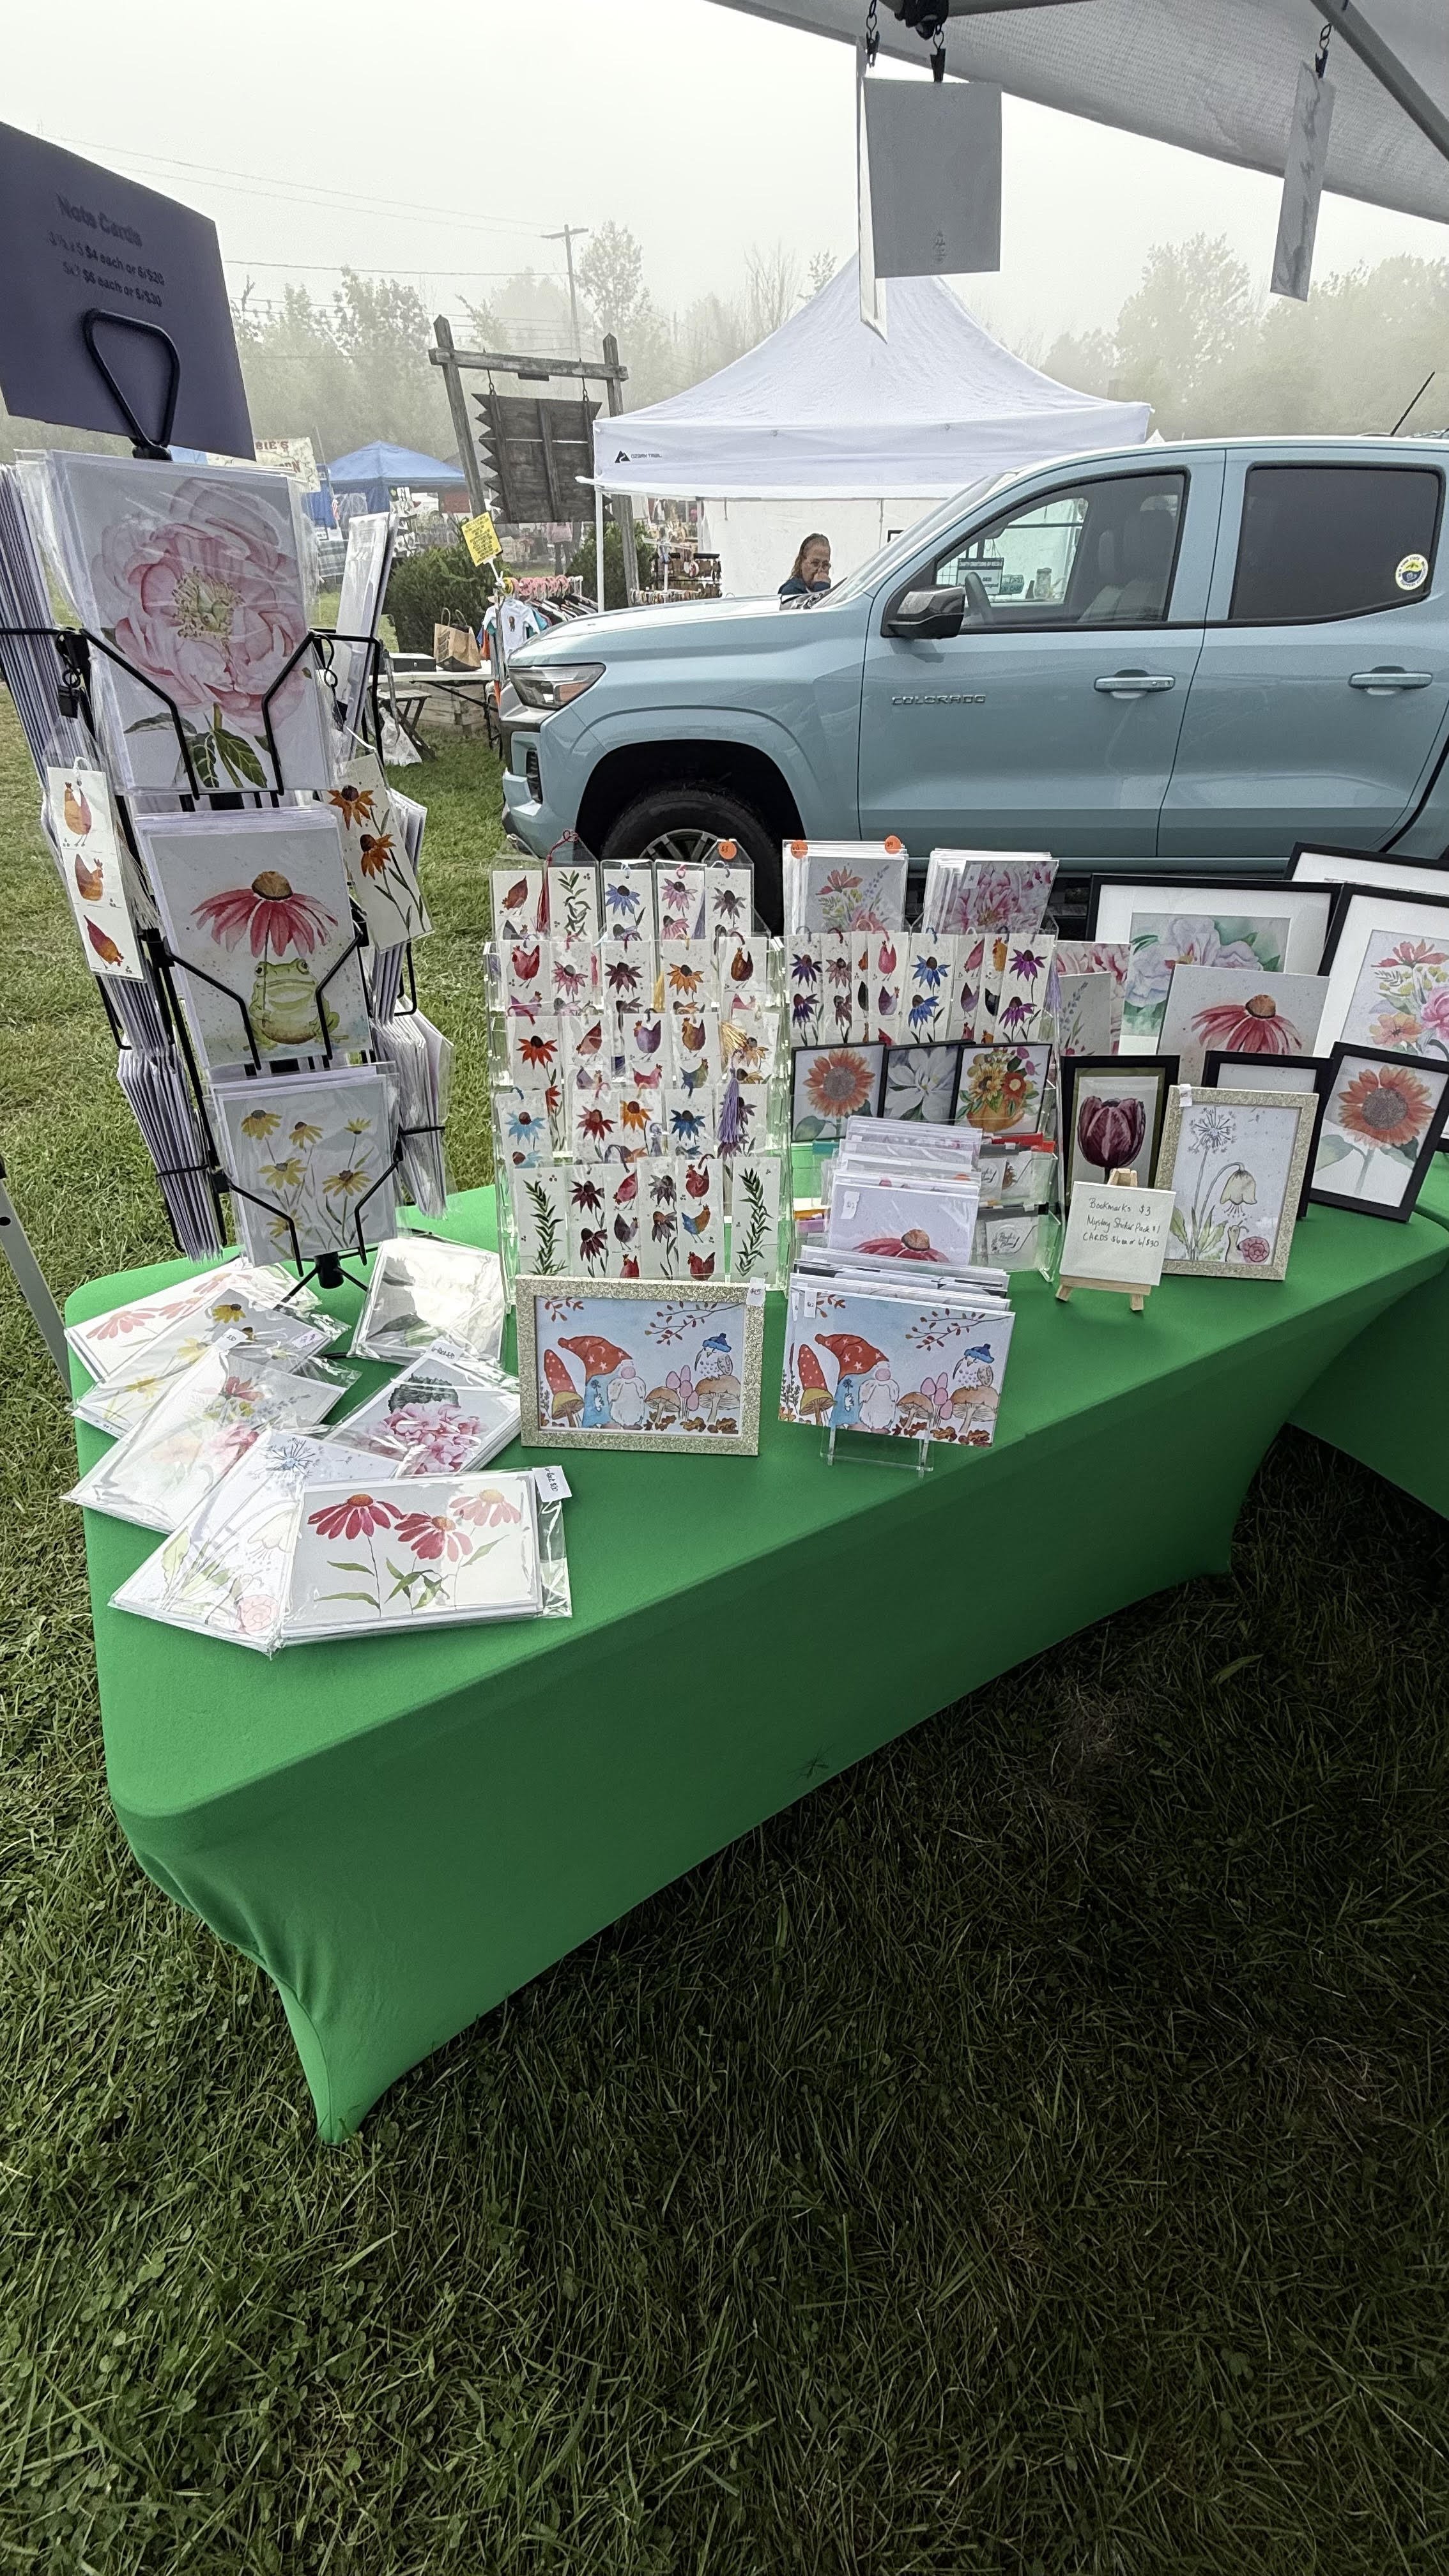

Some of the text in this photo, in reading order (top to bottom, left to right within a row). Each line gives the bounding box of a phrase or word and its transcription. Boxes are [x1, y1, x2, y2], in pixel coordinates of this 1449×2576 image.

[56, 193, 142, 249] Note Cards
[100, 254, 123, 270] each
[126, 264, 136, 273] or
[98, 276, 122, 293] each
[124, 286, 134, 296] or
[892, 694, 986, 705] COLORADO
[1089, 1197, 1151, 1216] Bookmarks $3
[1086, 1214, 1110, 1233] Mystery
[1114, 1216, 1133, 1232] Sticker
[1135, 1222, 1150, 1234] Pack
[1082, 1232, 1108, 1241] CARDS
[1138, 1236, 1160, 1248] 6/$30
